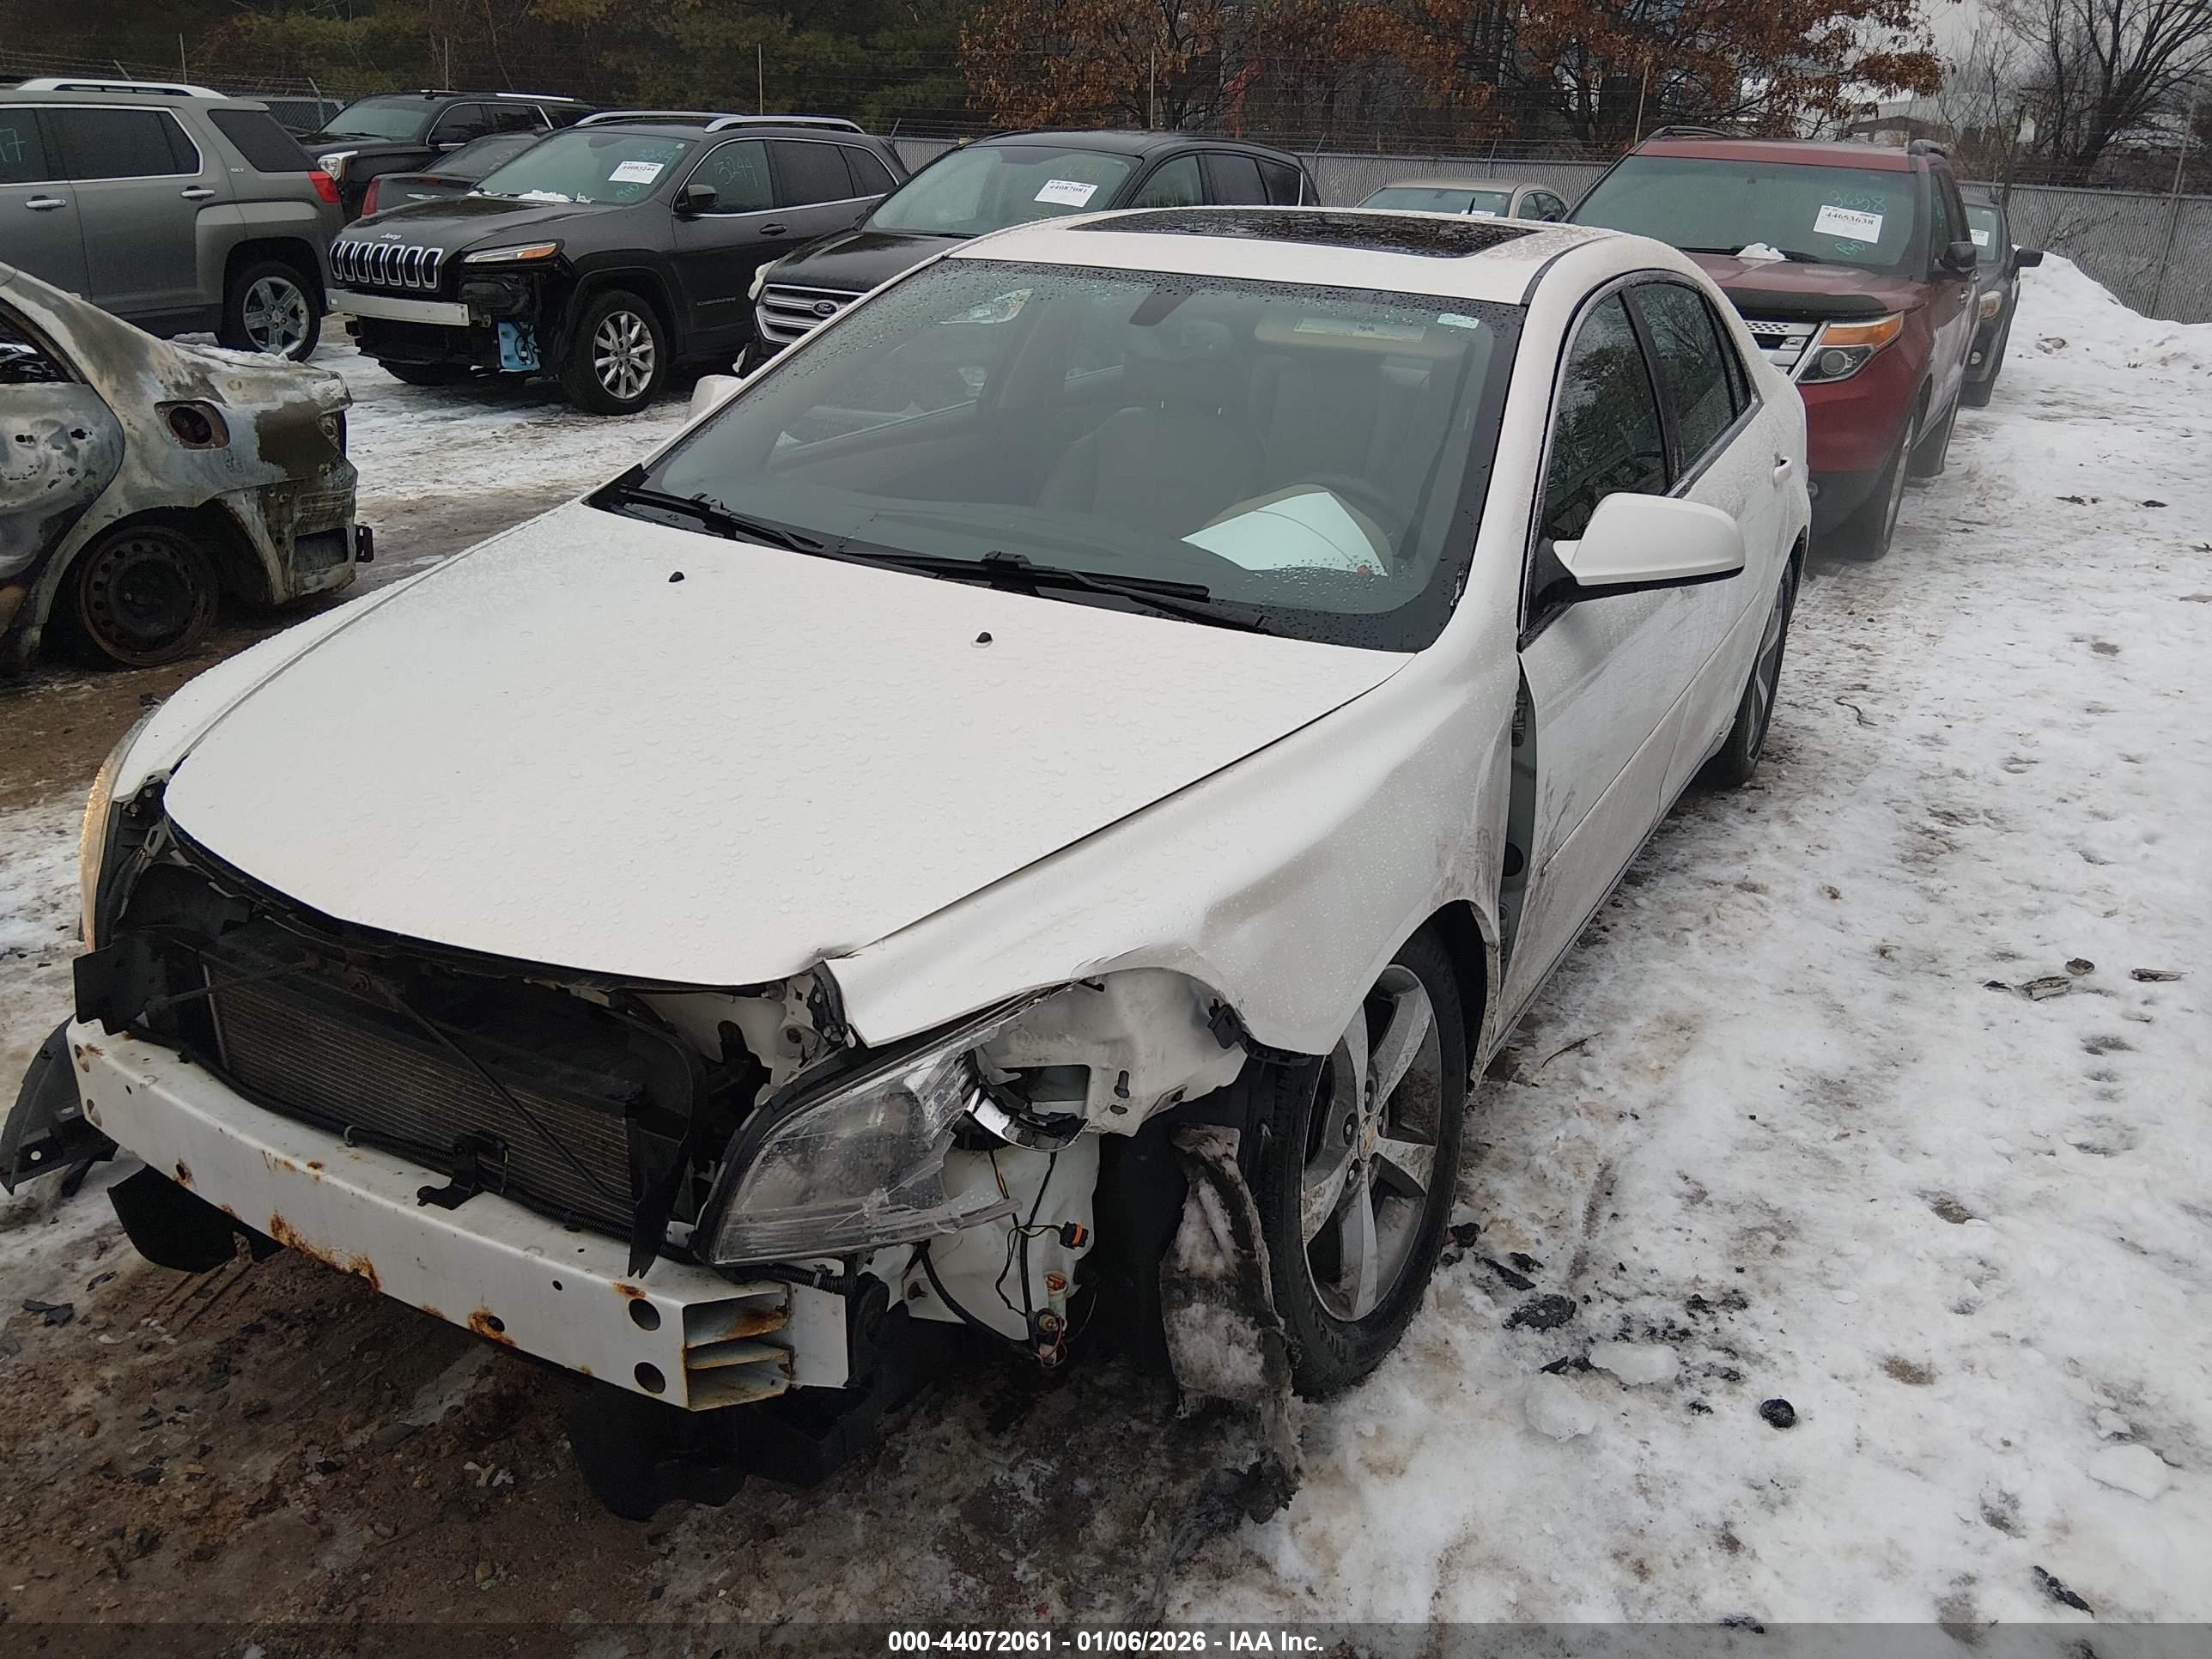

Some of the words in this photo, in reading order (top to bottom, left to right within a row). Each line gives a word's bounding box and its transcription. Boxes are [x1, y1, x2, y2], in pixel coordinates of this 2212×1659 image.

[714, 156, 758, 186] 3244
[1829, 190, 1887, 213] 3638
[1825, 211, 1875, 226] 44653638
[380, 233, 403, 241] Jeep
